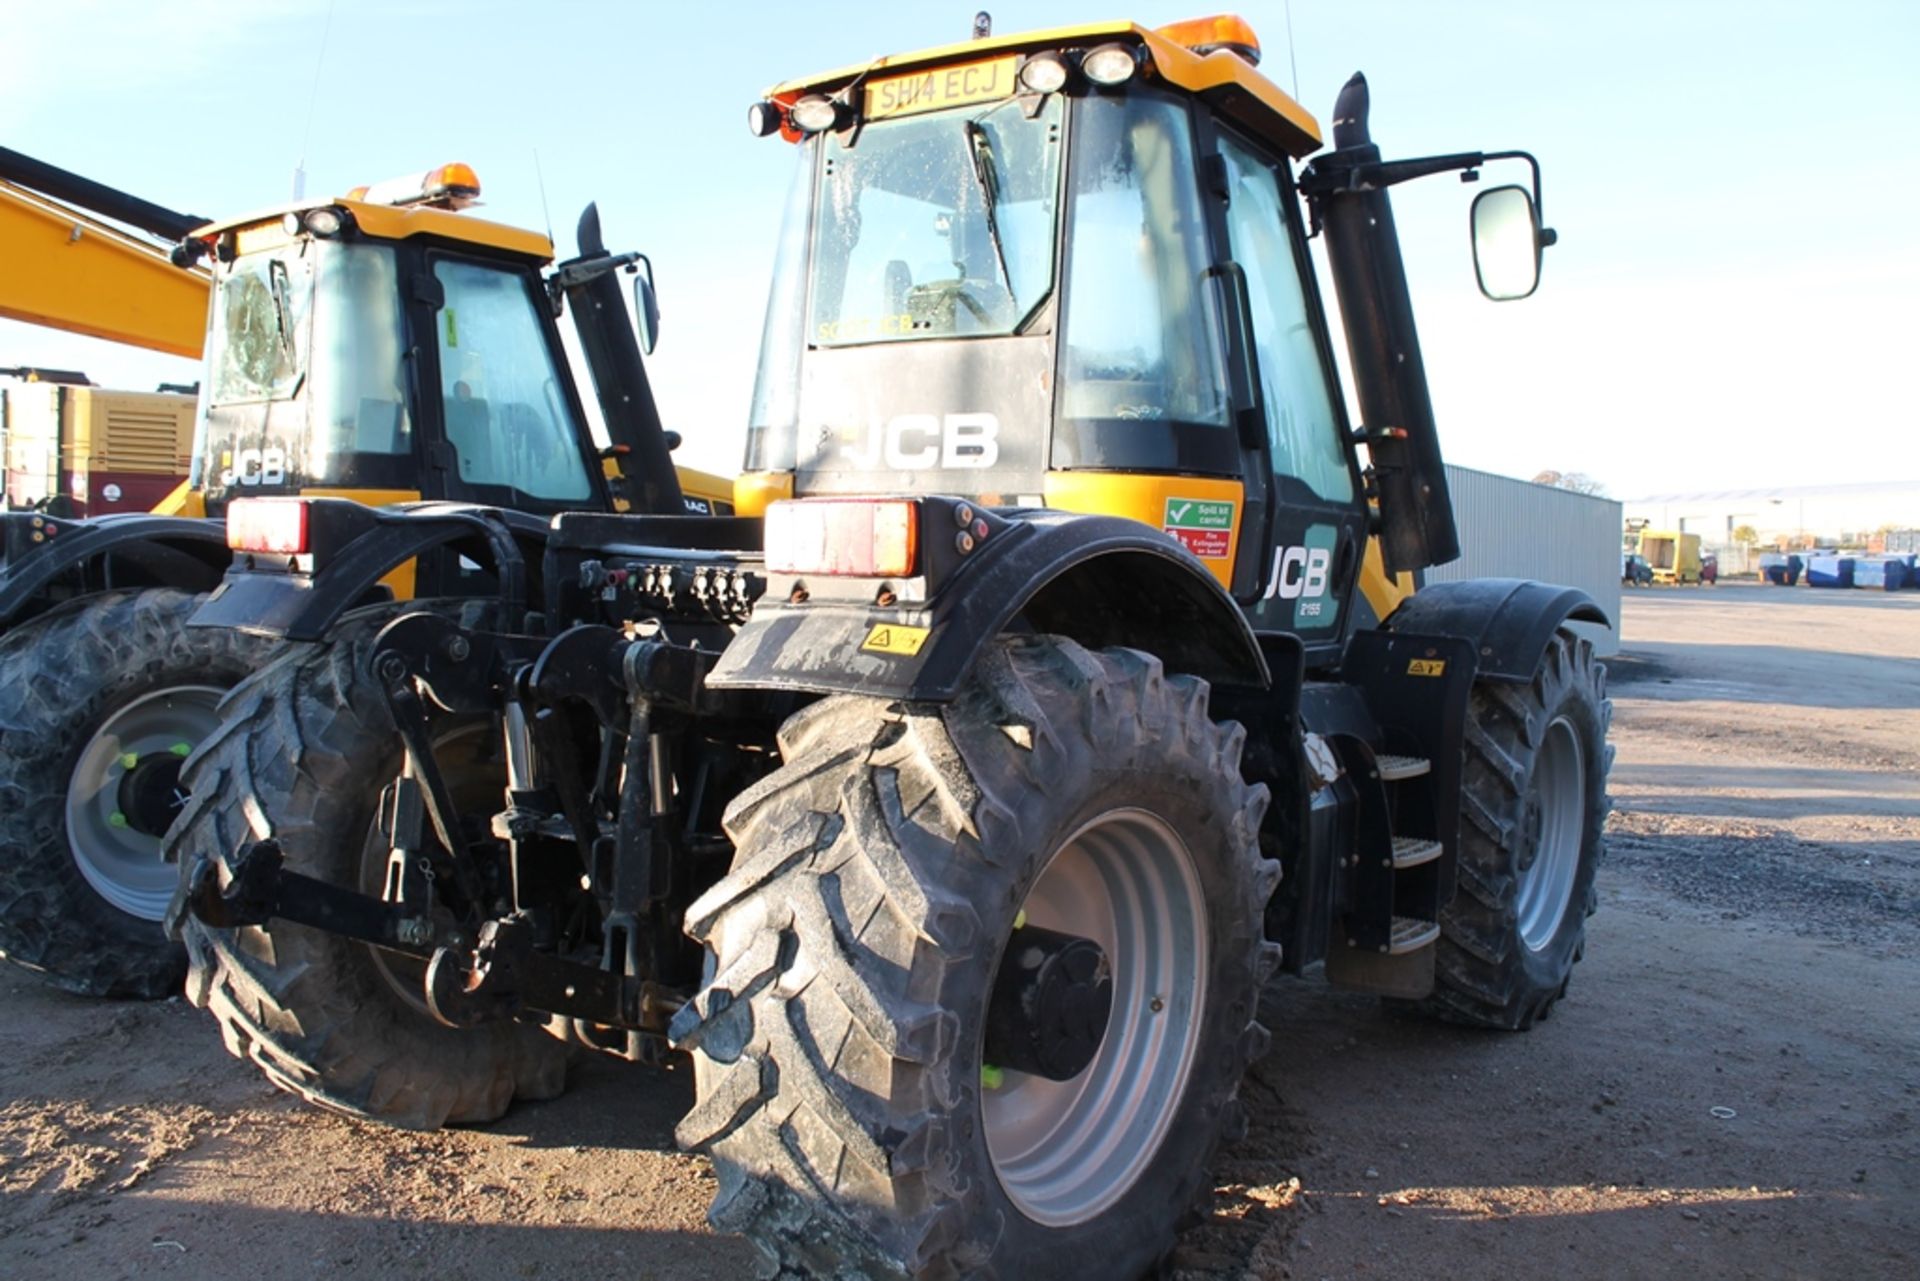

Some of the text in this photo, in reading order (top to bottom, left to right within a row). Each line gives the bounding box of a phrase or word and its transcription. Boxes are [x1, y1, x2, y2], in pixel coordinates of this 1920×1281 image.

[880, 63, 998, 109] SH14 ECJ
[839, 412, 999, 470] JCB
[221, 448, 285, 486] JCB
[1198, 504, 1217, 514] Spill
[1263, 545, 1329, 599] JCB
